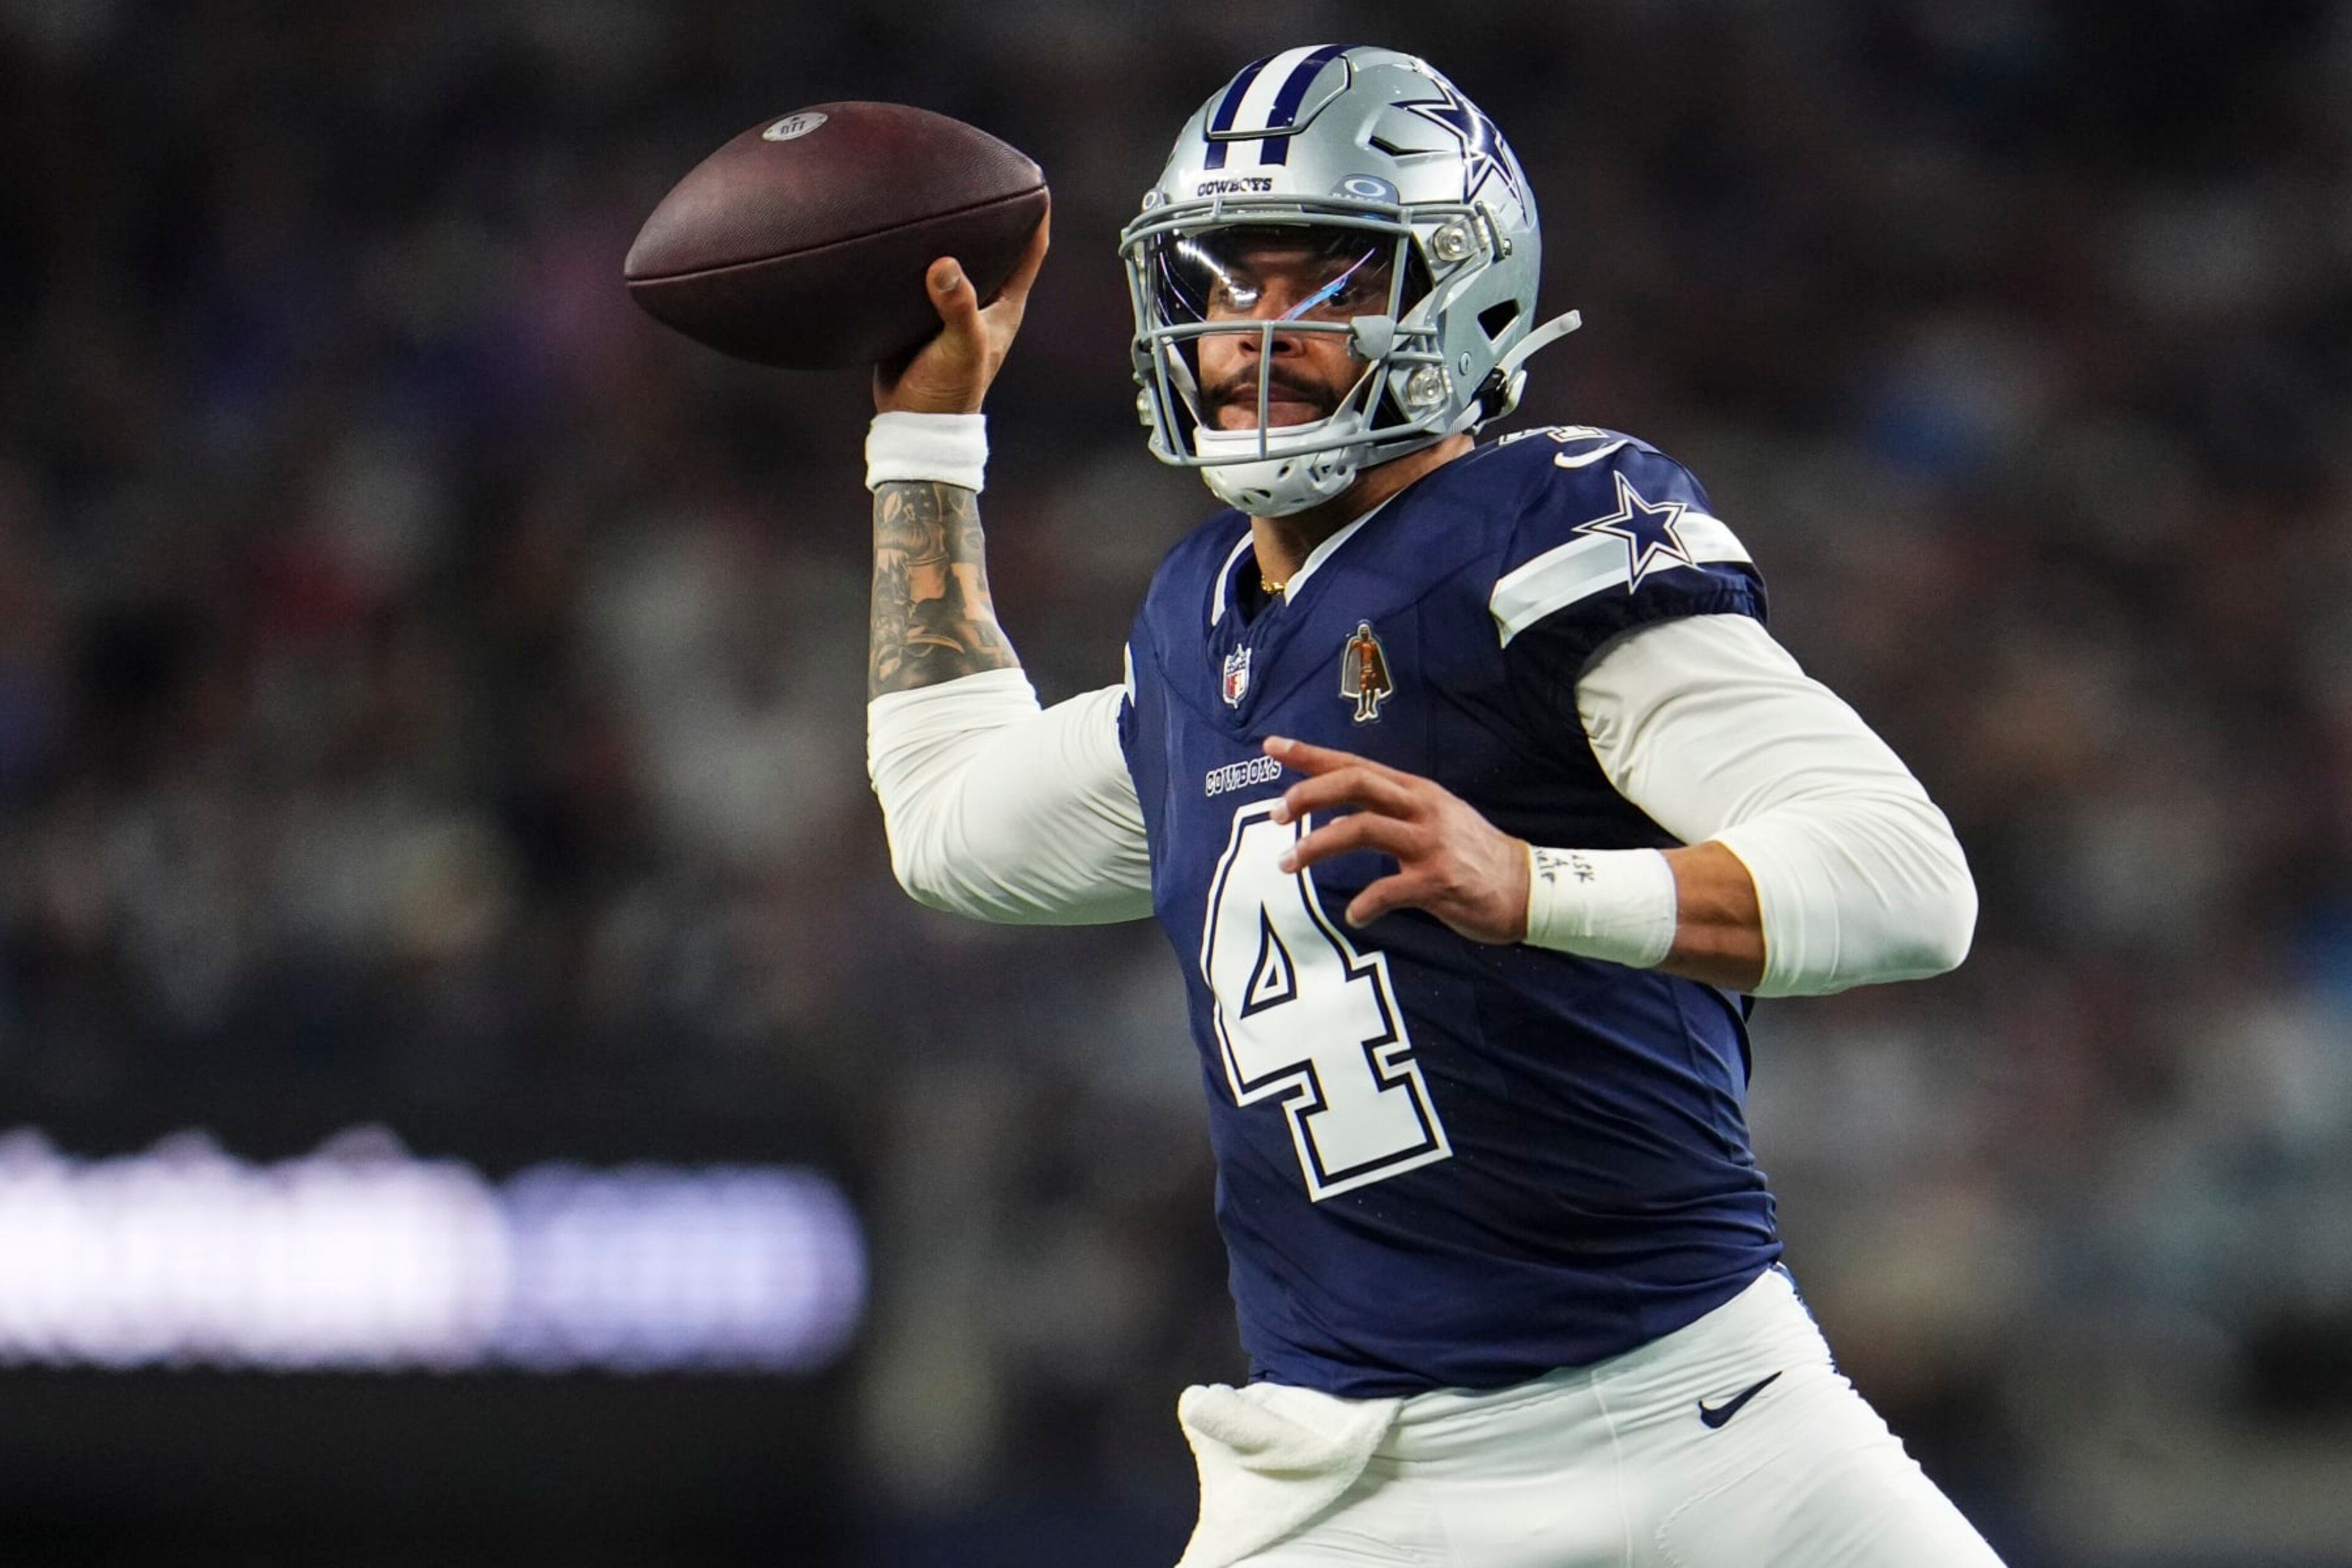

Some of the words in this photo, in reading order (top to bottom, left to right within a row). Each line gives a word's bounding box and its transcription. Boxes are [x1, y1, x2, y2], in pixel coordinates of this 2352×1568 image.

[1197, 177, 1273, 197] COWBOYS
[1205, 755, 1282, 796] COWBOYS
[1200, 796, 1453, 1202] 4
